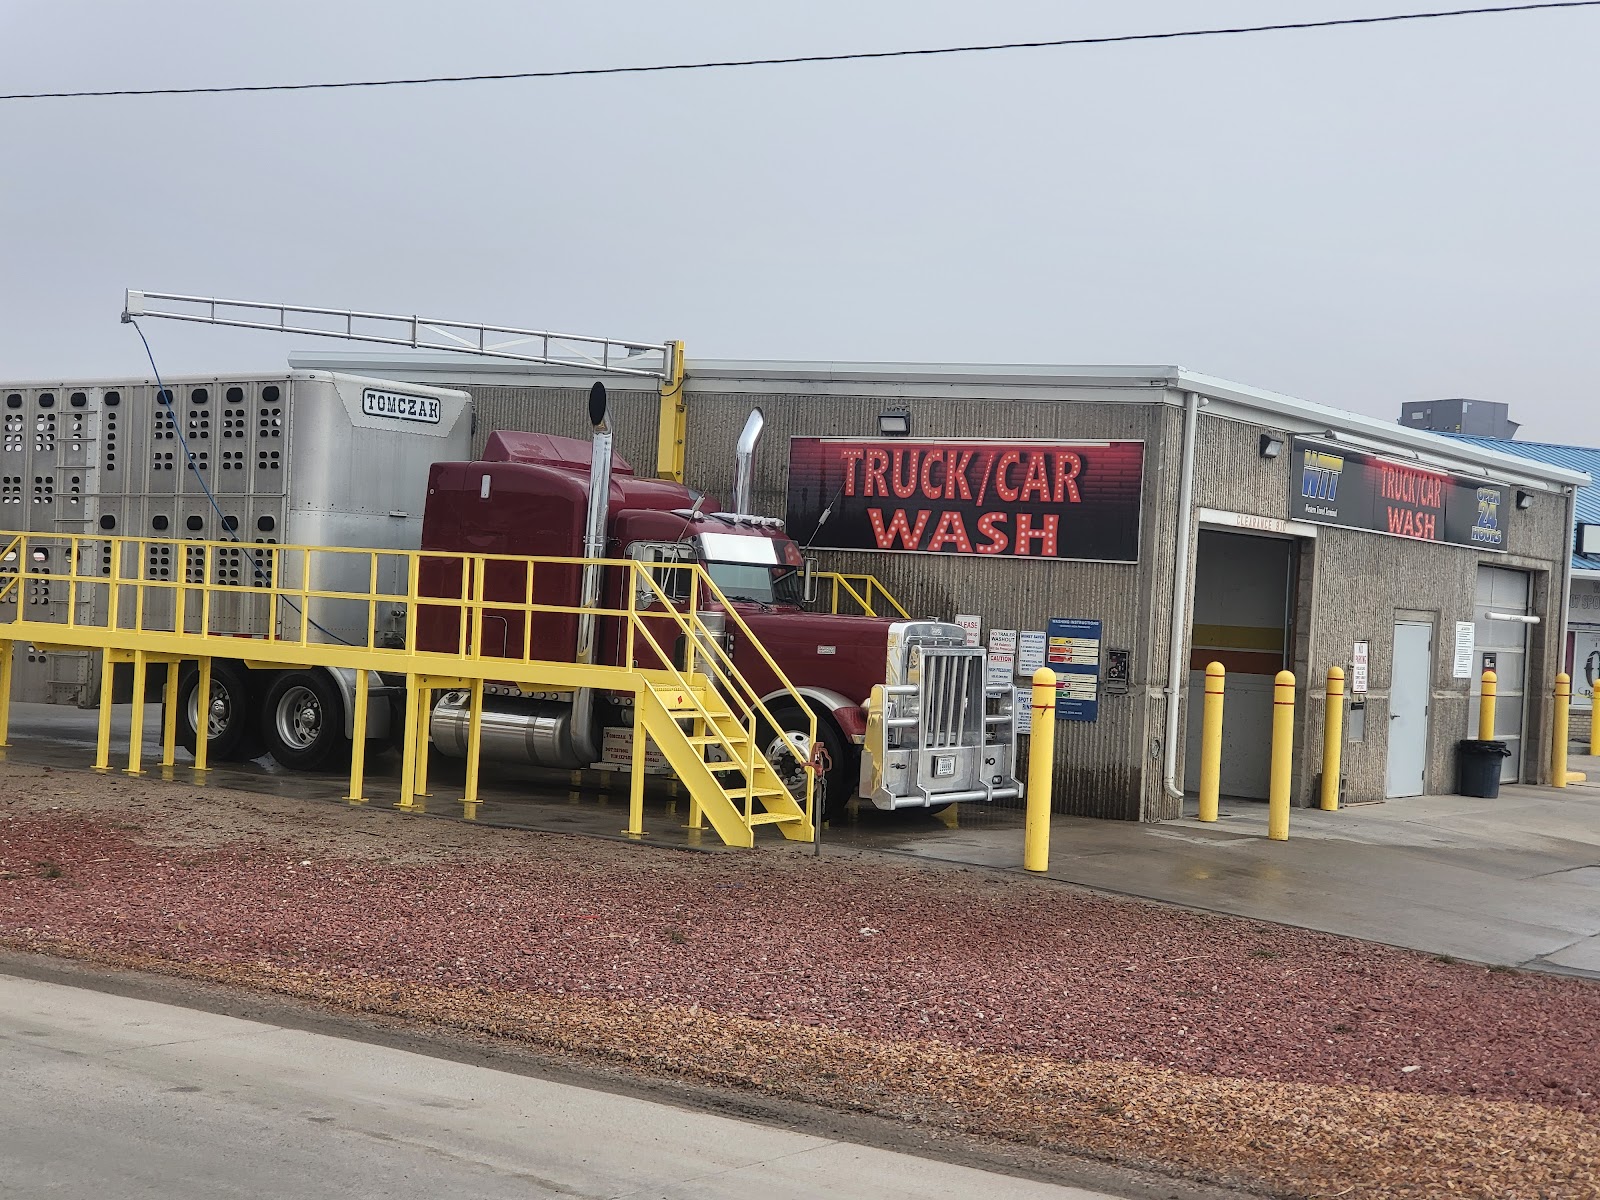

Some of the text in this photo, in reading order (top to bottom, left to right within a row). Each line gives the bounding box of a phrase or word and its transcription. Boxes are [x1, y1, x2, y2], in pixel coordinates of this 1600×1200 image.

[366, 393, 438, 419] TOMCZAK
[840, 448, 1082, 507] TRUCK/CAR
[1381, 465, 1442, 508] TRUCK/CAR
[1477, 487, 1500, 506] OPEN
[1236, 514, 1272, 530] CLEARANCE
[1387, 506, 1436, 540] WASH
[1477, 501, 1498, 530] 24
[866, 508, 1060, 557] WASH
[1471, 525, 1502, 545] HOURS
